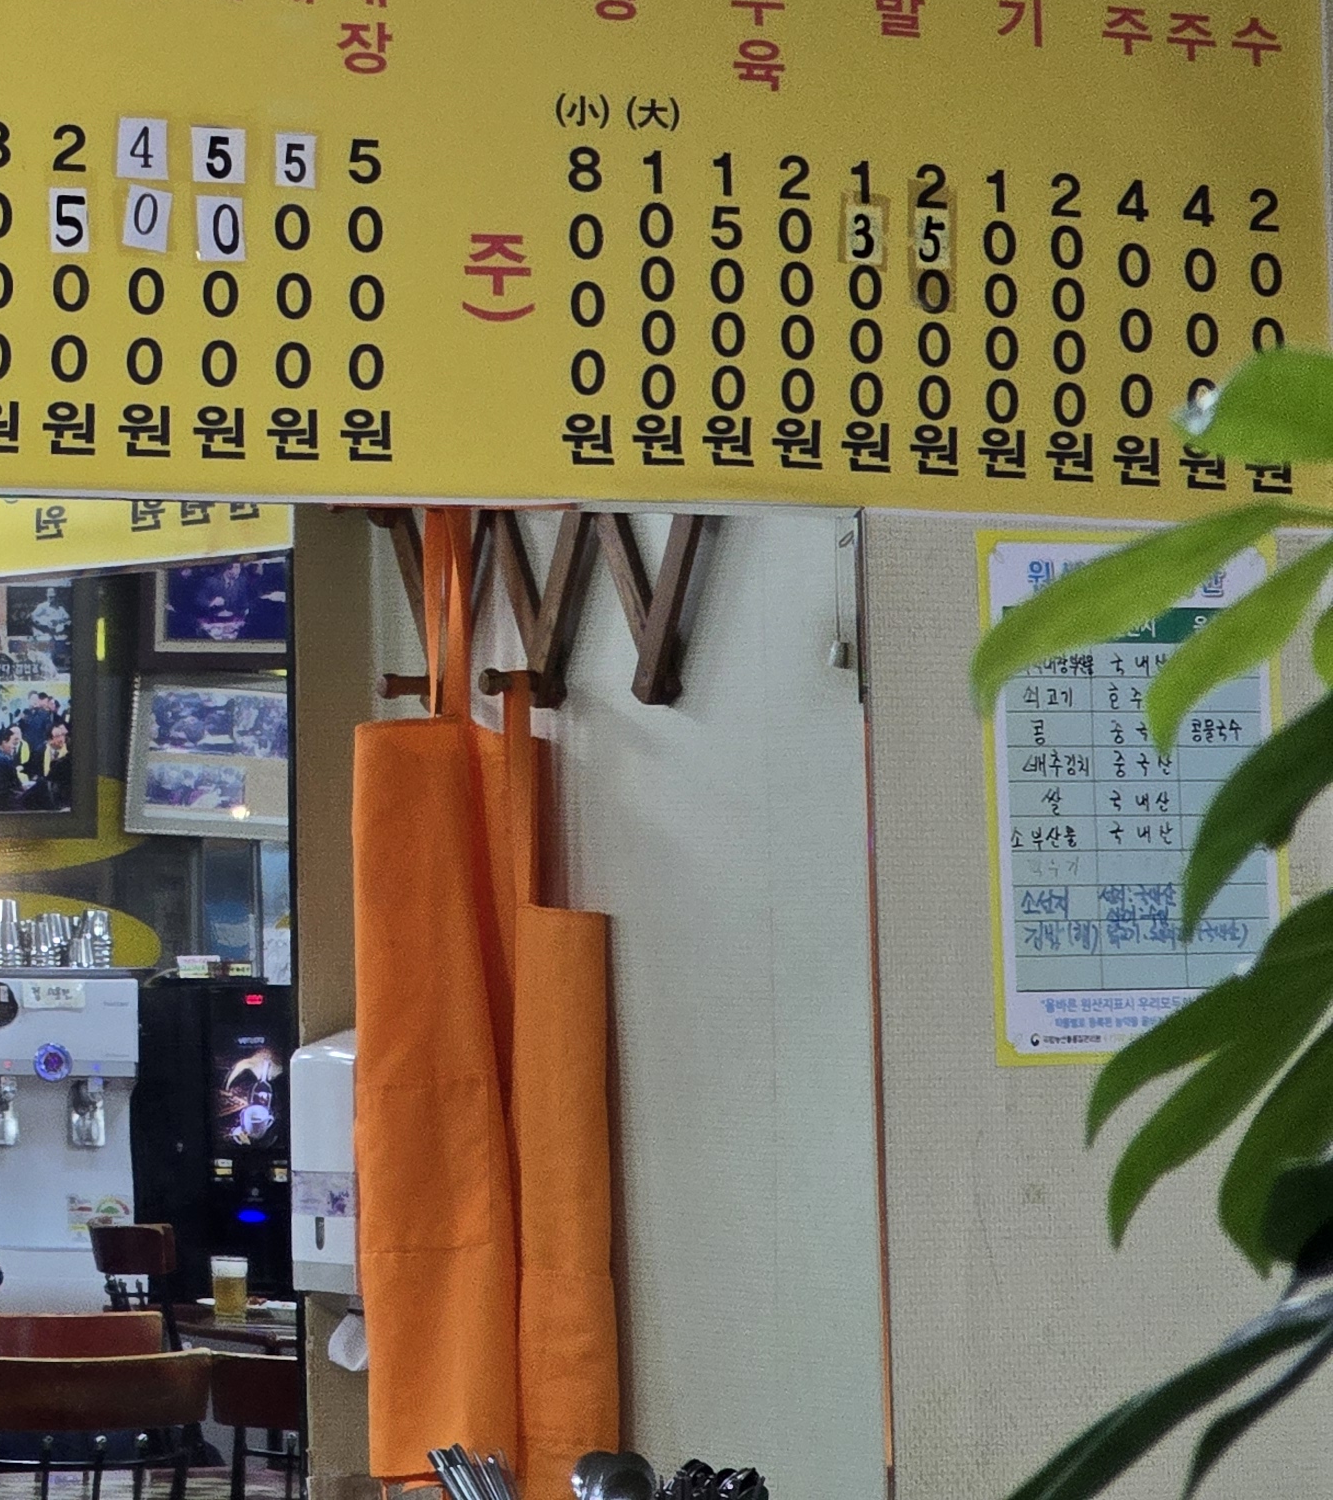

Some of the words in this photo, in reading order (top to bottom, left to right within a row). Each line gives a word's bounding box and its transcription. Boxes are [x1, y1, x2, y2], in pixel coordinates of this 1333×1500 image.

[556, 93, 609, 129] (小)
[627, 96, 679, 131] (大)
[42, 124, 95, 456] 2500원
[118, 126, 171, 458] 4000원
[193, 136, 245, 460] 5000원
[267, 143, 319, 460] 5000원
[340, 139, 392, 461] 5000원
[562, 146, 615, 465] 8000원
[632, 150, 685, 466] 10000원
[702, 152, 754, 467] 15000원
[772, 155, 823, 470] 20000원
[839, 160, 891, 473] 13000원
[908, 164, 959, 476] 25000원
[978, 169, 1026, 479] 10000원
[1046, 173, 1094, 483] 20000원
[1113, 179, 1160, 487] 4000원
[1245, 188, 1293, 494] 200원
